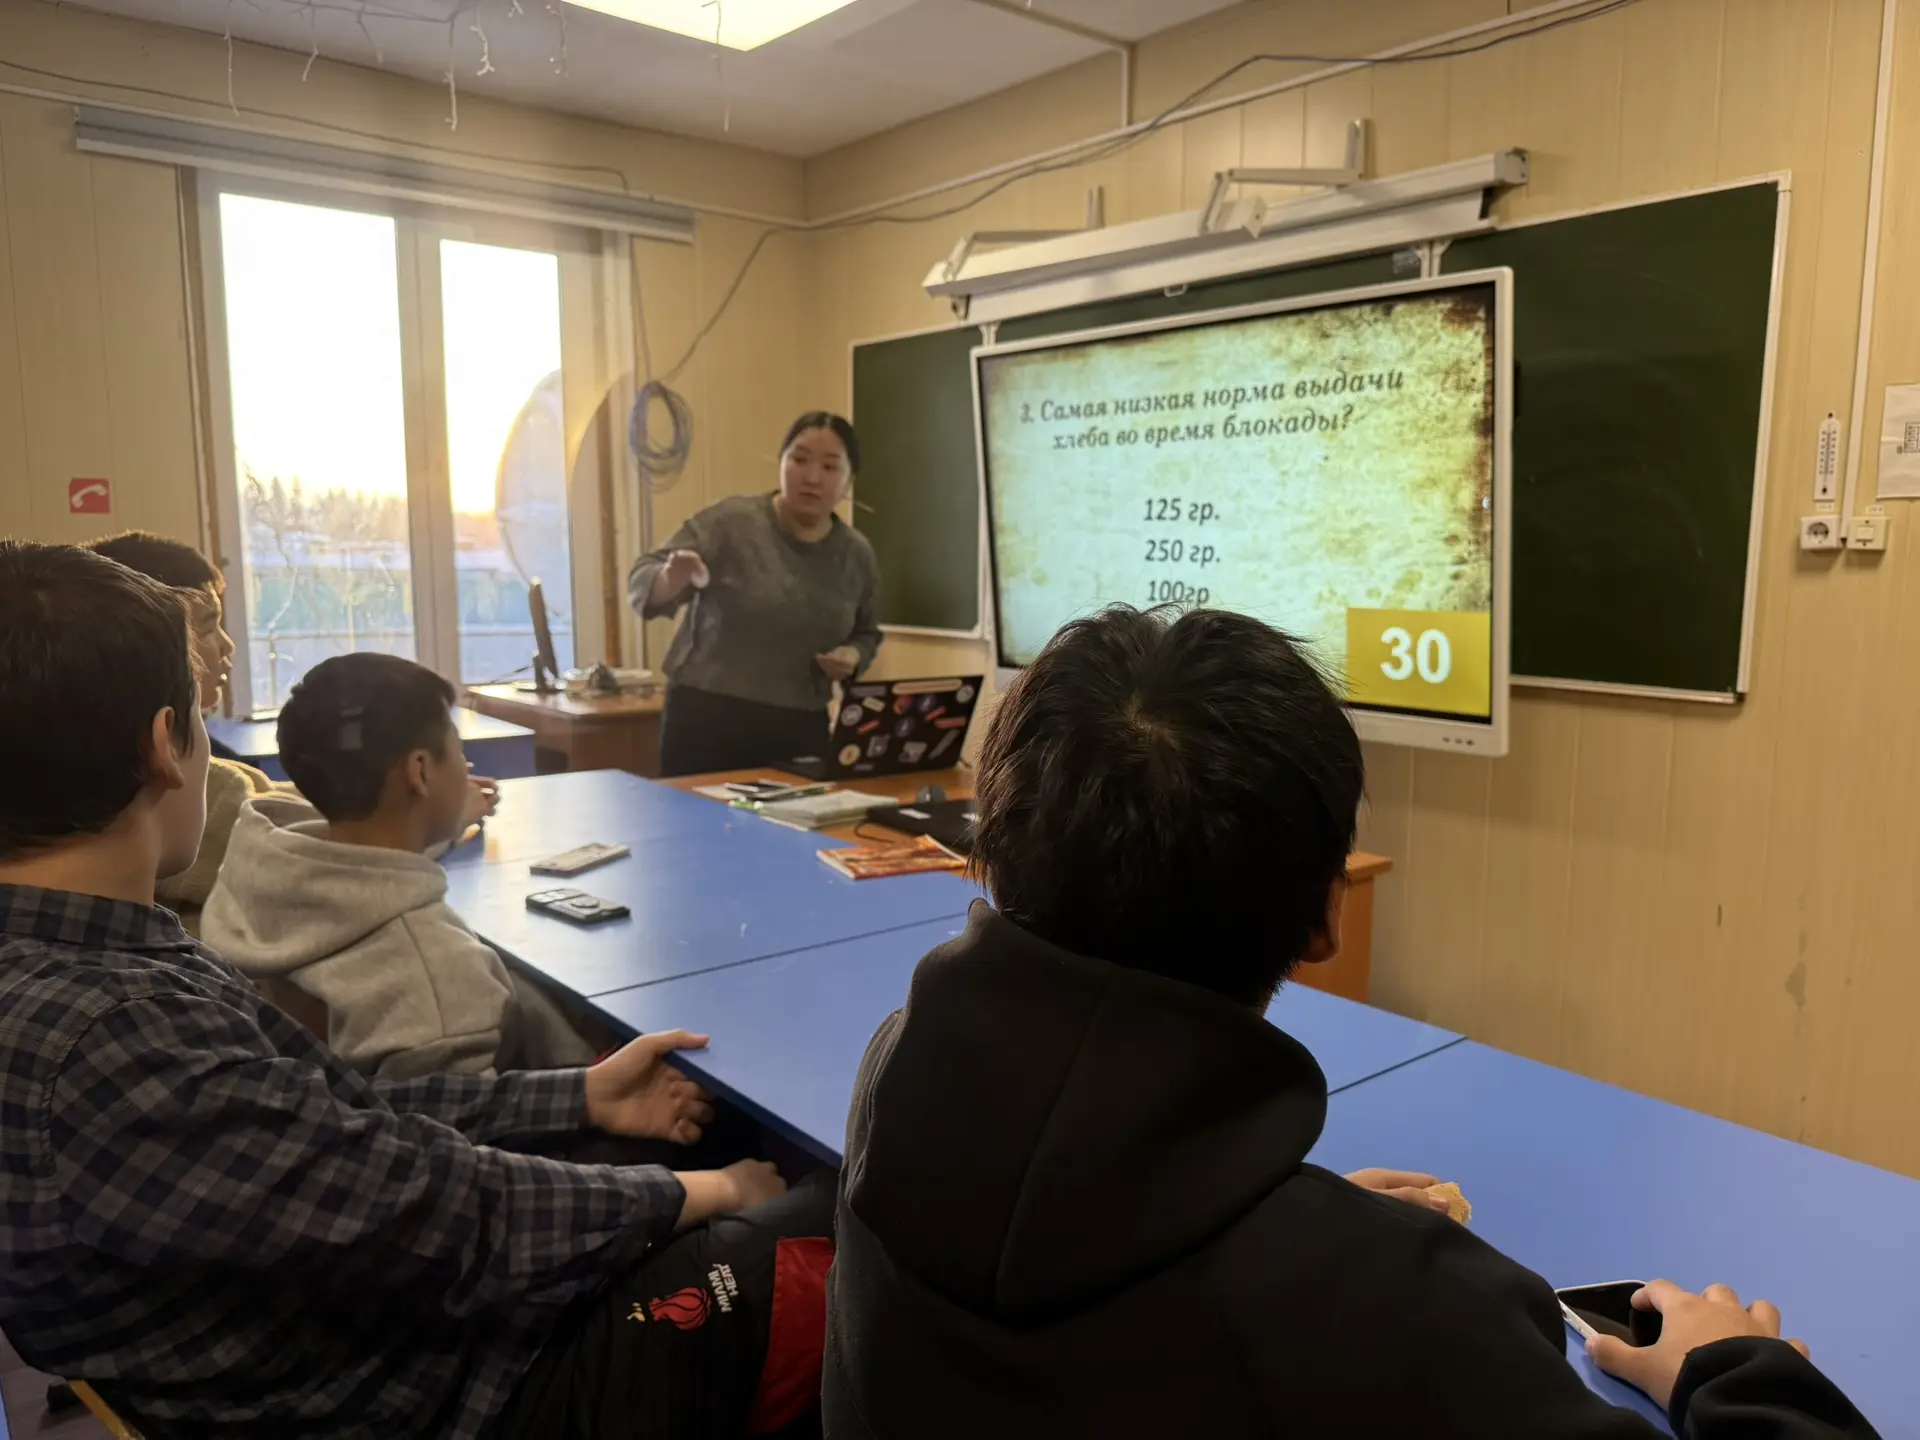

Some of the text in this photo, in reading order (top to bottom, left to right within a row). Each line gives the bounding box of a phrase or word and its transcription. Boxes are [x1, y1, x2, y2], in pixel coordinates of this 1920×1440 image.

[1040, 399, 1107, 422] Самая
[1113, 392, 1195, 416] низкая
[1202, 382, 1285, 411] норма
[1294, 366, 1404, 399] выдачи
[1052, 402, 1354, 450] хлеба во время блокады?
[1143, 498, 1220, 526] 125 гр.
[1145, 539, 1221, 568] 250 гр.
[1380, 626, 1452, 685] 30
[707, 1270, 732, 1312] MIAMI
[712, 1263, 739, 1296] HEAT
